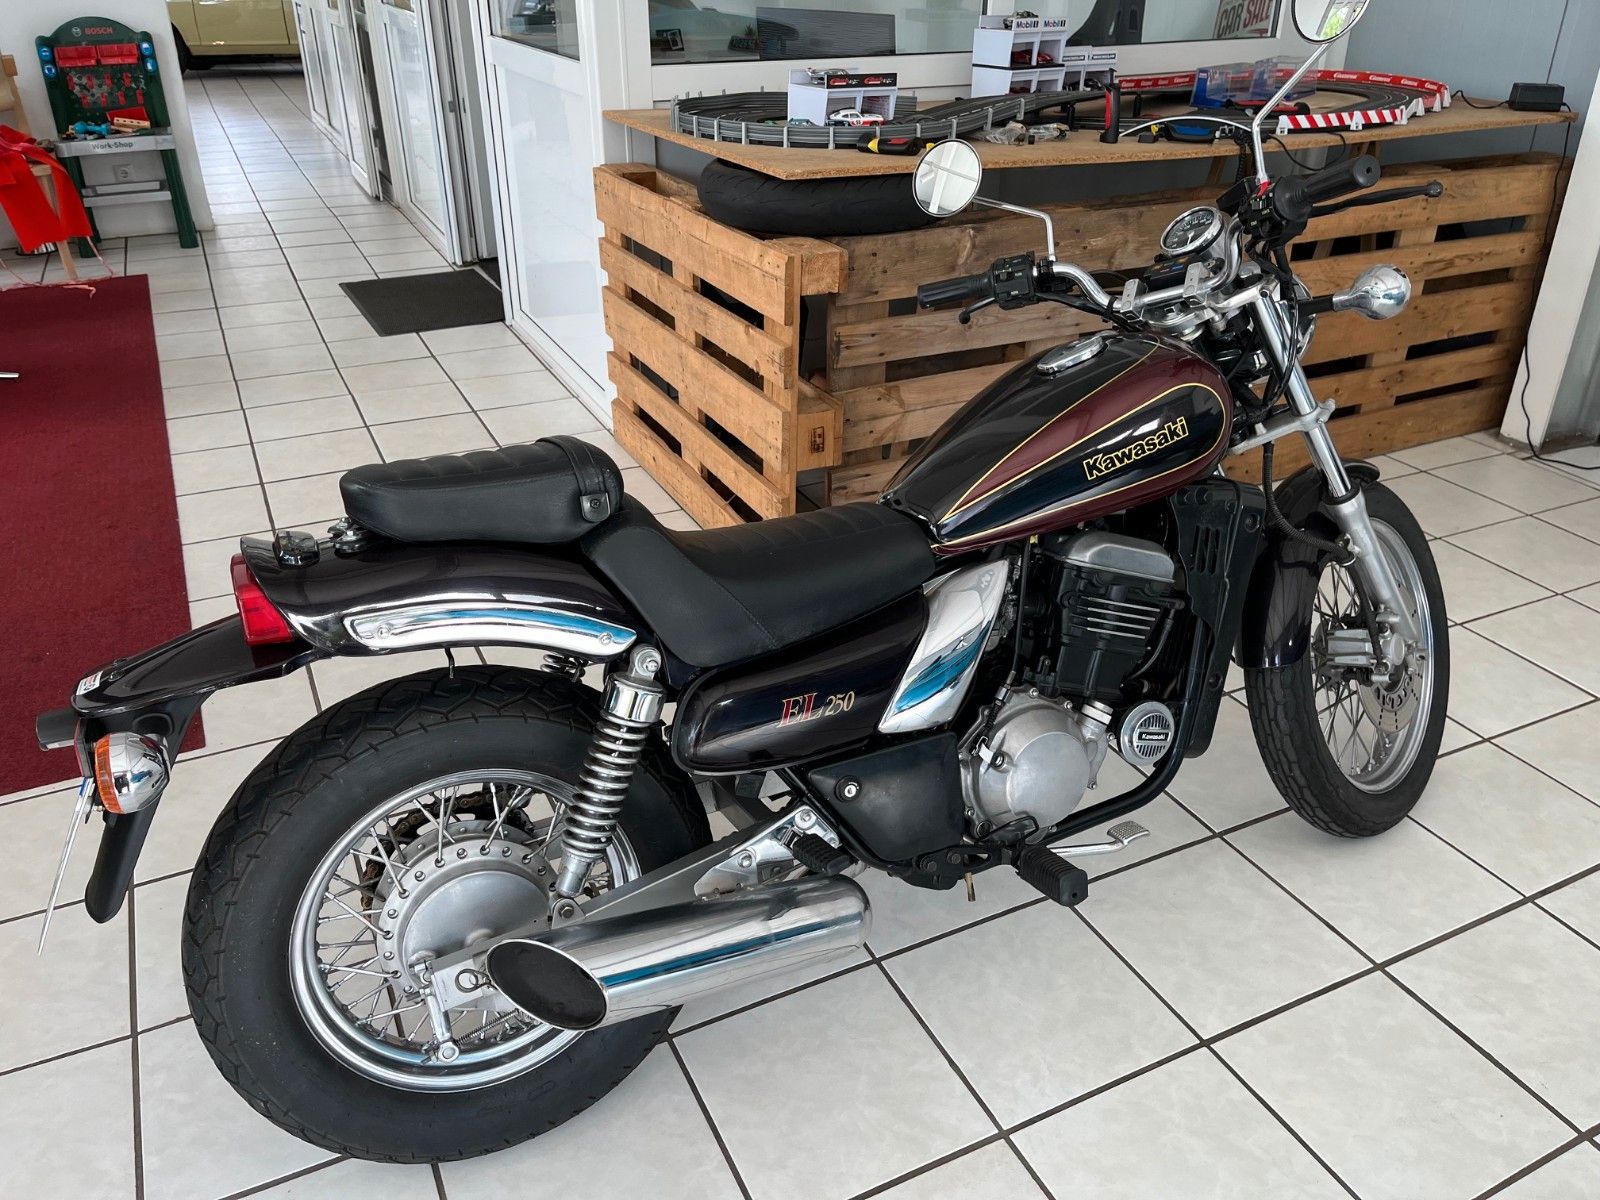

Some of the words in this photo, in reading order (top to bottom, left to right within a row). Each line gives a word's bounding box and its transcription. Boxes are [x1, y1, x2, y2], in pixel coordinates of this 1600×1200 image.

[84, 26, 113, 35] BOSCH
[1217, 3, 1244, 38] CAR
[91, 141, 134, 149] Work-Shop
[1082, 415, 1189, 480] Kawasaki
[776, 692, 822, 728] EL
[824, 690, 855, 717] 250
